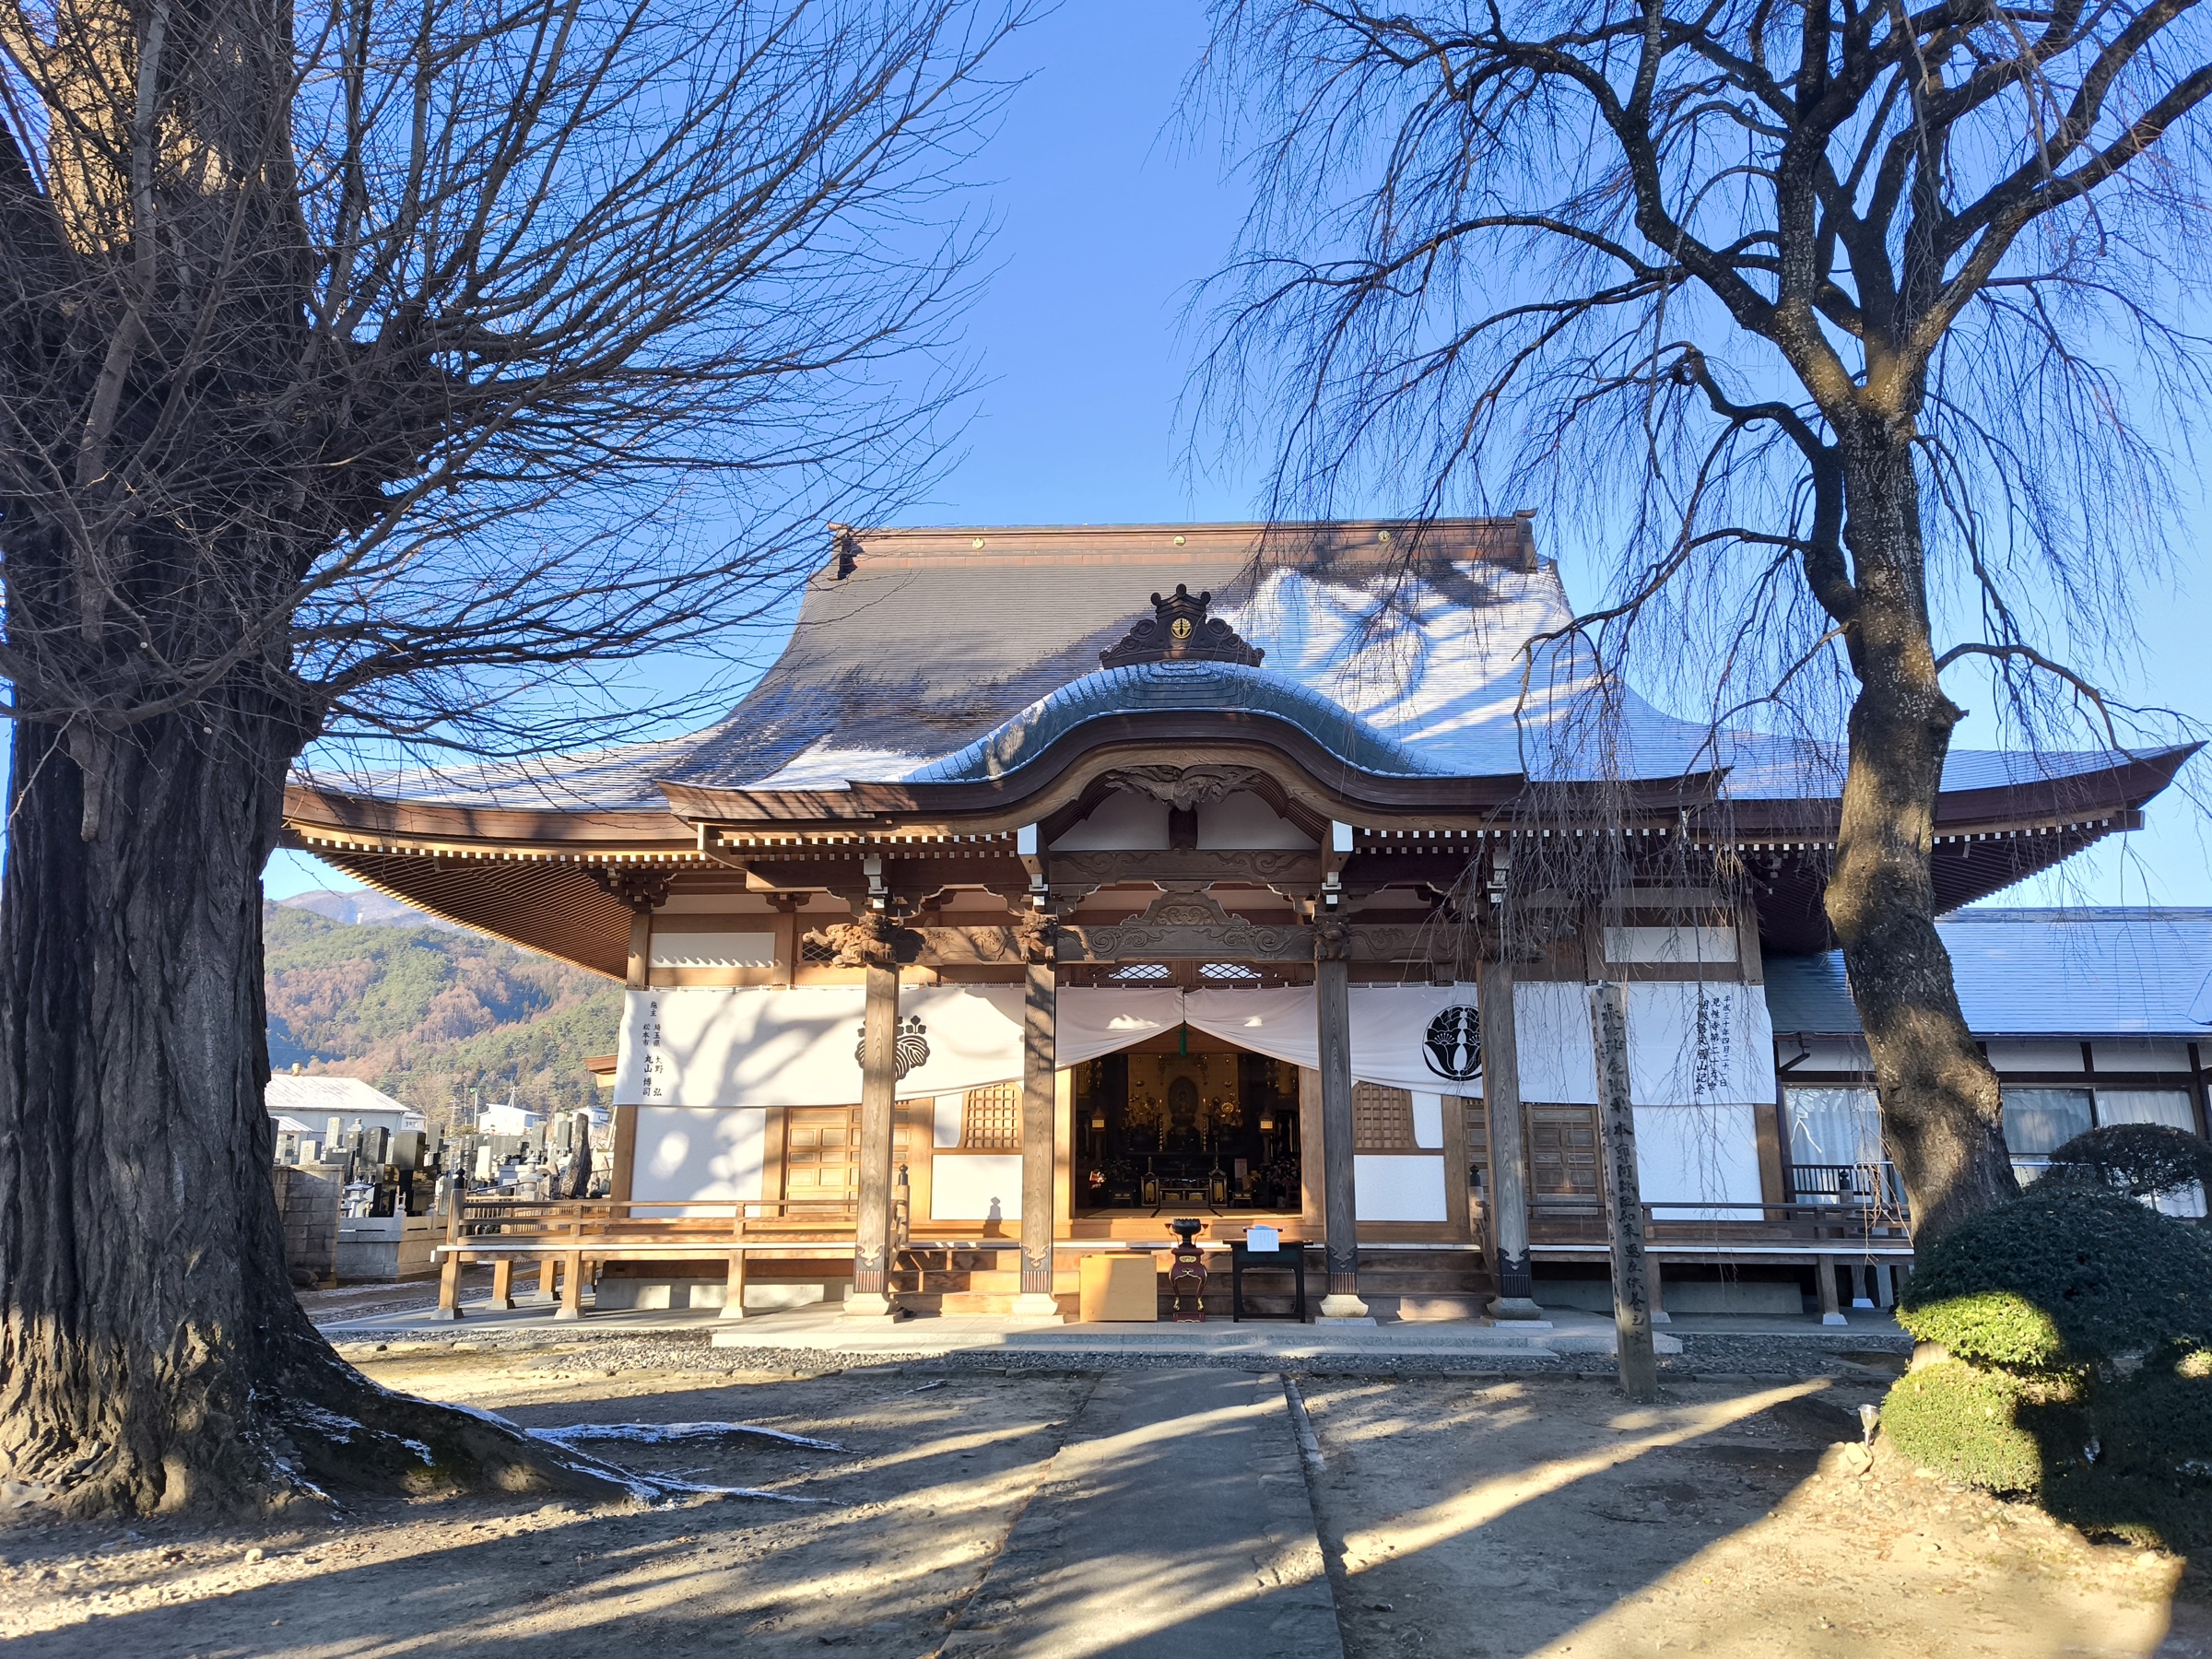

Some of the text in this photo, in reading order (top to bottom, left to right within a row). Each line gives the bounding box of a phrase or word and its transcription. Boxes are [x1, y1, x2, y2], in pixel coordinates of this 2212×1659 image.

[650, 1001, 658, 1018] 施主
[641, 1023, 651, 1047] 松本市
[653, 1023, 662, 1048] 埼玉県
[1720, 995, 1731, 1088] 平成三十年四月二十一日
[643, 1054, 653, 1074] 丸山
